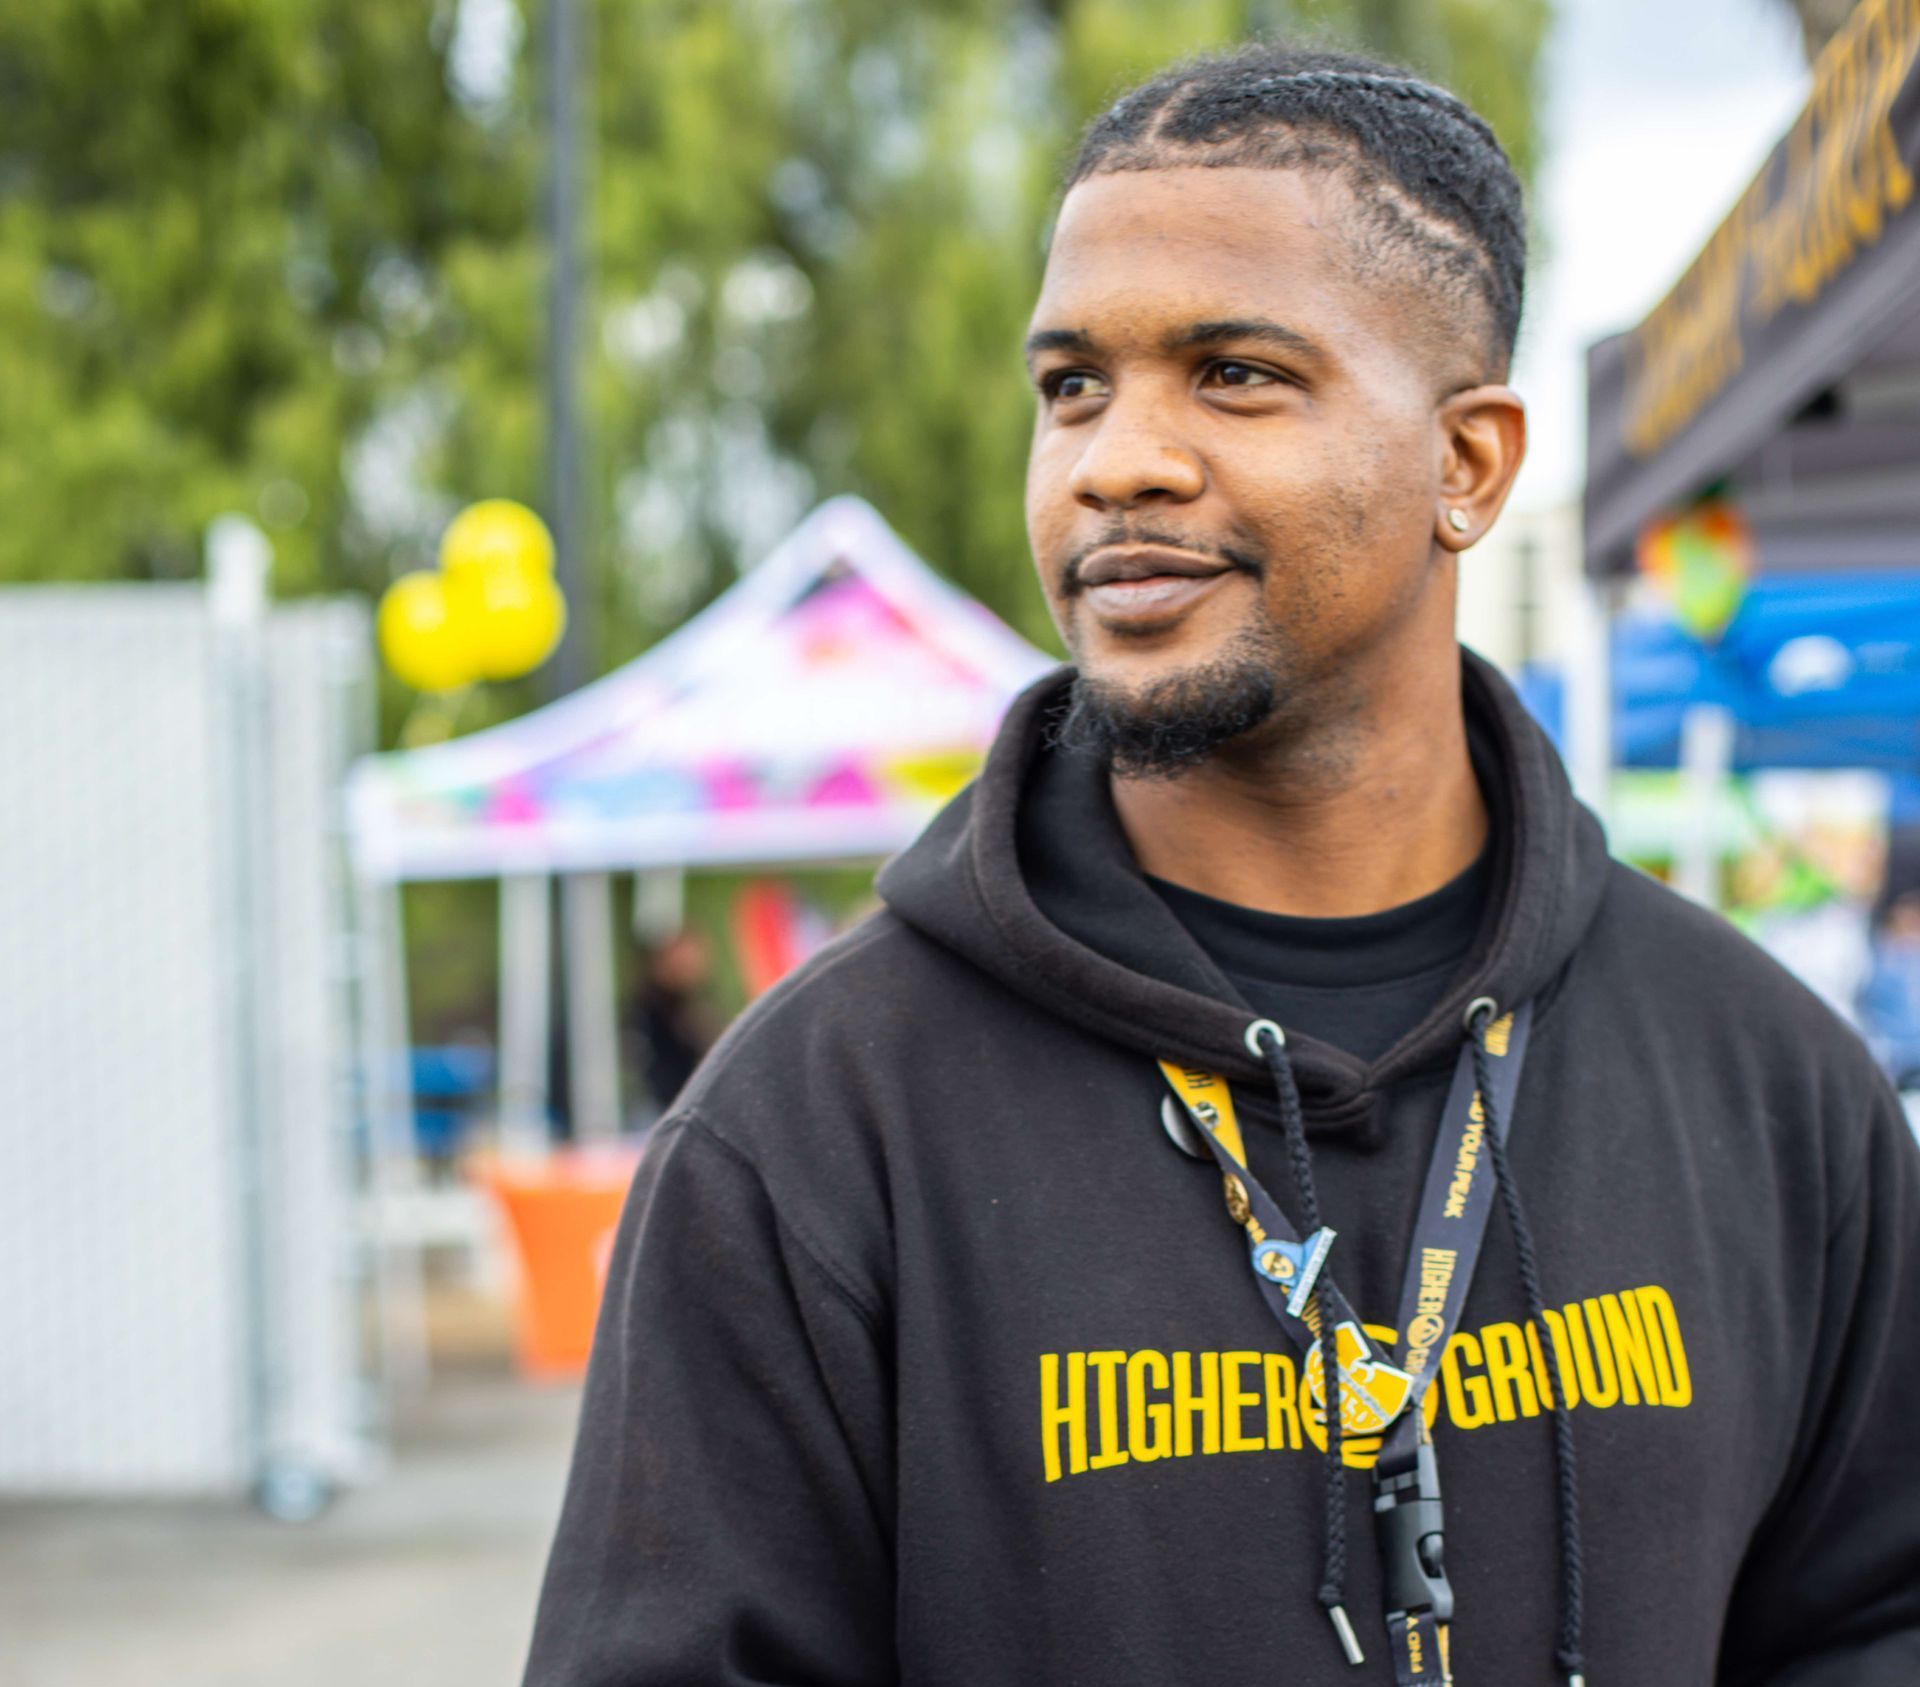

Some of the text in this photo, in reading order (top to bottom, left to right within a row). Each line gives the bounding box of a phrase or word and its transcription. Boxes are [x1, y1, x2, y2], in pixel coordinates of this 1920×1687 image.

[1456, 1123, 1485, 1170] YOUR
[1443, 1169, 1472, 1218] PEAK
[1415, 1247, 1457, 1319] HIGHER
[1040, 1349, 1303, 1483] HIGHER
[1440, 1284, 1693, 1430] GROUND
